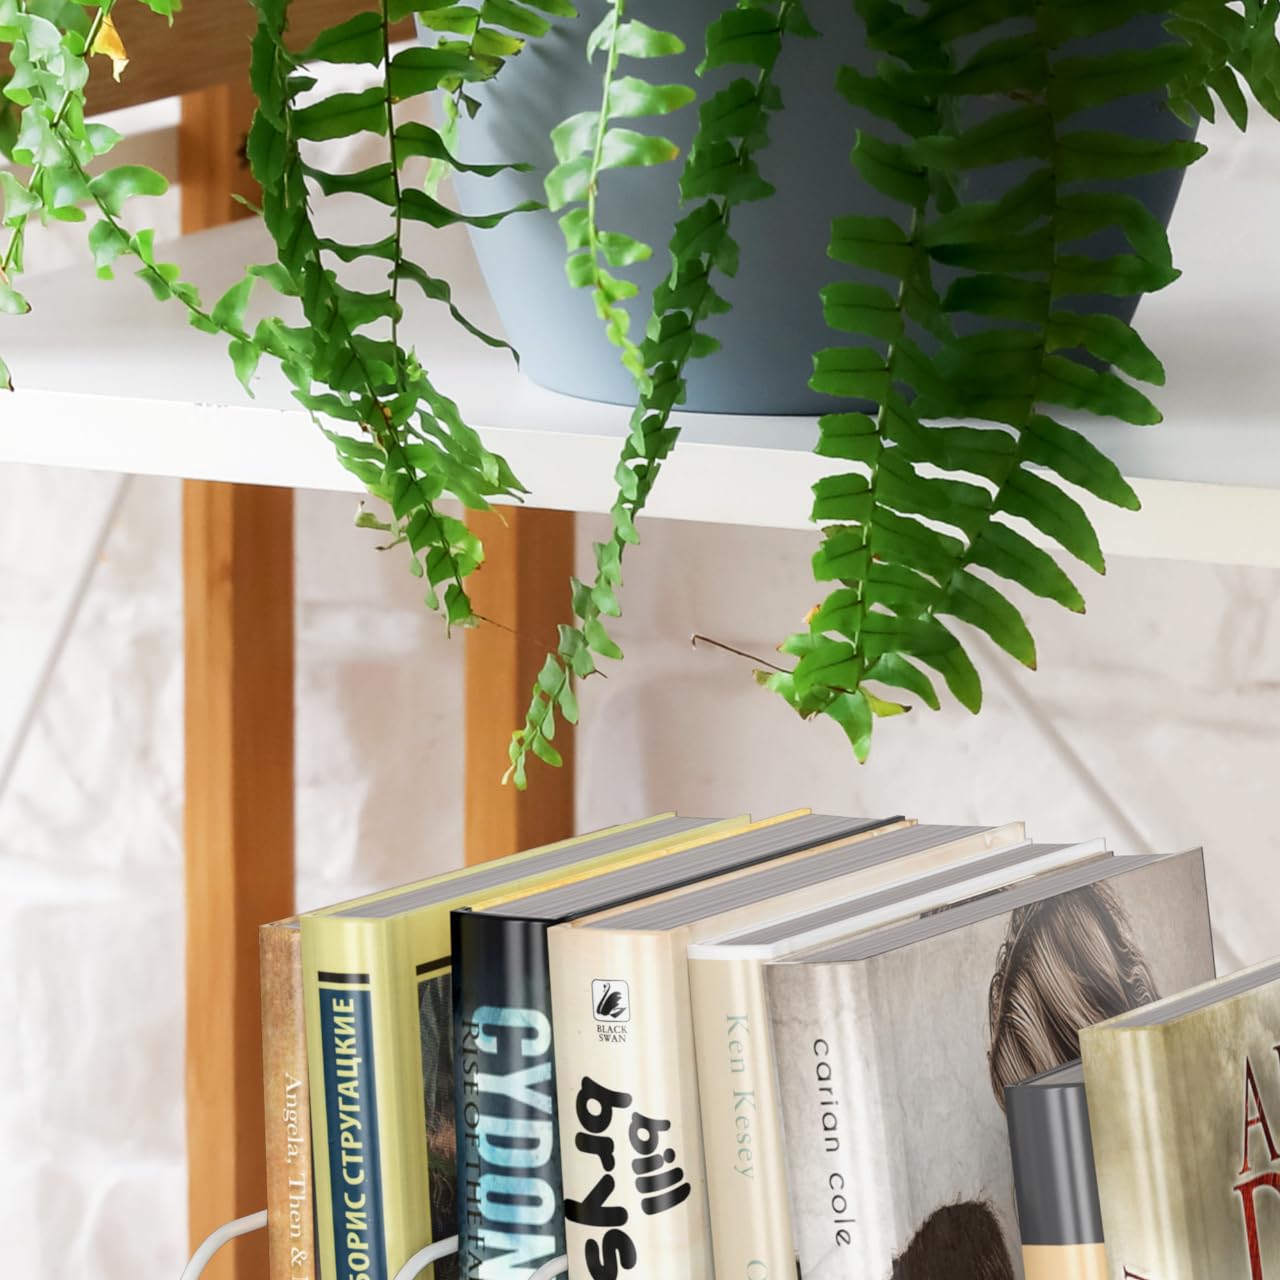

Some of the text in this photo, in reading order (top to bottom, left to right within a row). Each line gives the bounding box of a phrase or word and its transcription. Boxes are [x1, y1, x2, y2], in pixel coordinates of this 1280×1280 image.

[461, 1021, 480, 1095] RISE
[597, 1024, 628, 1033] BLACK
[599, 1034, 626, 1043] SWAN
[333, 998, 365, 1185] СТРУГАЦКИЕ
[726, 1013, 758, 1179] Ken Kesey
[464, 1101, 481, 1151] OF
[813, 1038, 856, 1247] carian cole
[465, 1159, 483, 1225] THE
[629, 1112, 692, 1215] bill
[288, 1171, 309, 1238] Then
[291, 1247, 308, 1267] &
